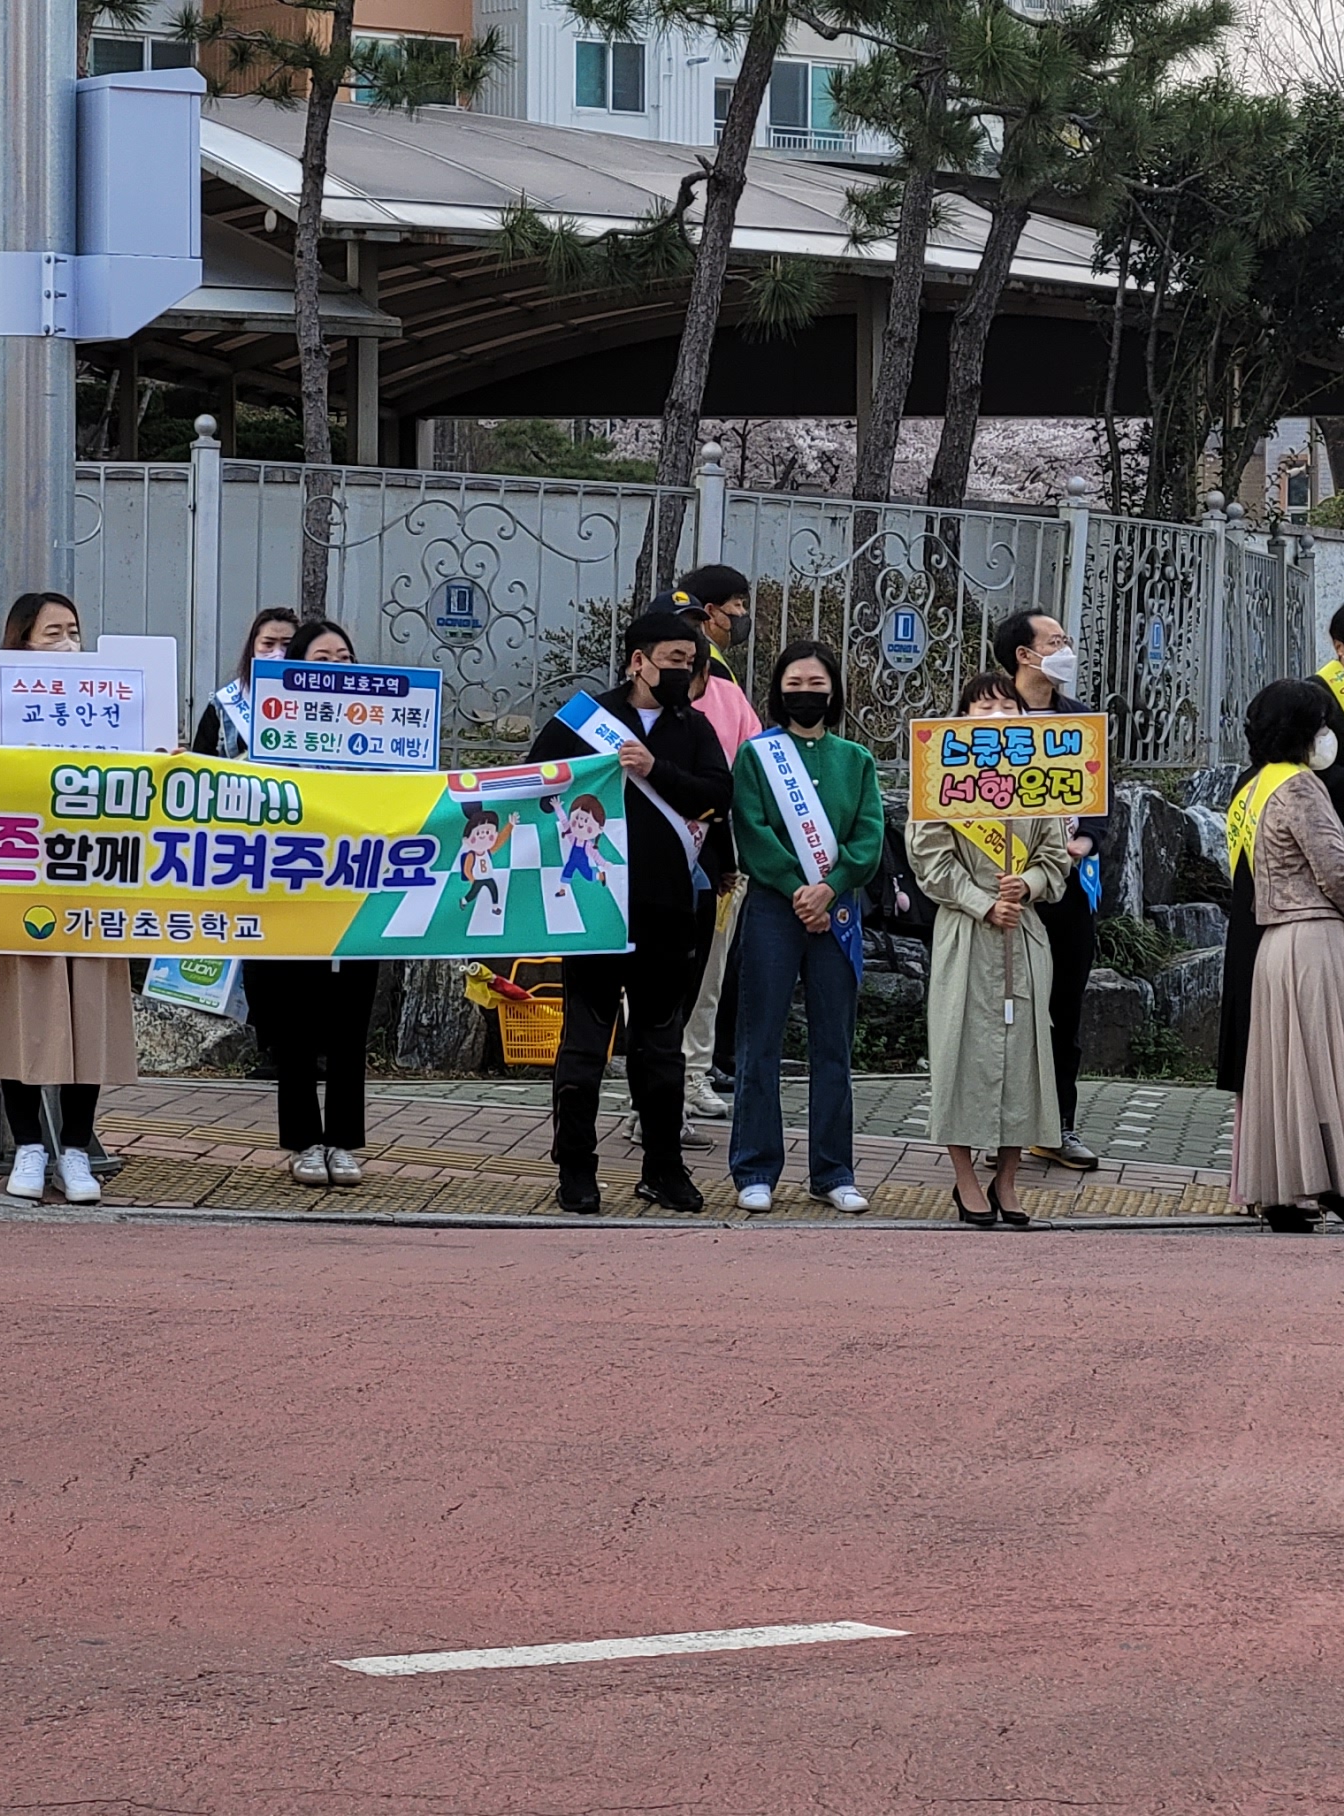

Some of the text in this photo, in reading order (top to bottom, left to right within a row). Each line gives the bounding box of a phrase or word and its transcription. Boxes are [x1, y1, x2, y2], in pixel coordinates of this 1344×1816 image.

[11, 677, 135, 698] 스스로 지키는
[293, 672, 401, 696] 어린이 보호구역
[21, 701, 122, 728] 교통안전
[391, 706, 430, 728] 저쪽!
[303, 731, 343, 754] 동안!
[391, 737, 430, 759] 예방!
[941, 725, 1082, 768] 스쿨존 내
[51, 763, 303, 826] 엄마 아빠!!
[768, 739, 793, 775] 사람이
[783, 778, 810, 817] 보이면
[801, 819, 823, 848] 일단
[43, 832, 141, 885] 함께
[150, 829, 439, 891] 지켜주세요
[478, 858, 489, 874] B
[64, 908, 263, 941] 가람초등학교
